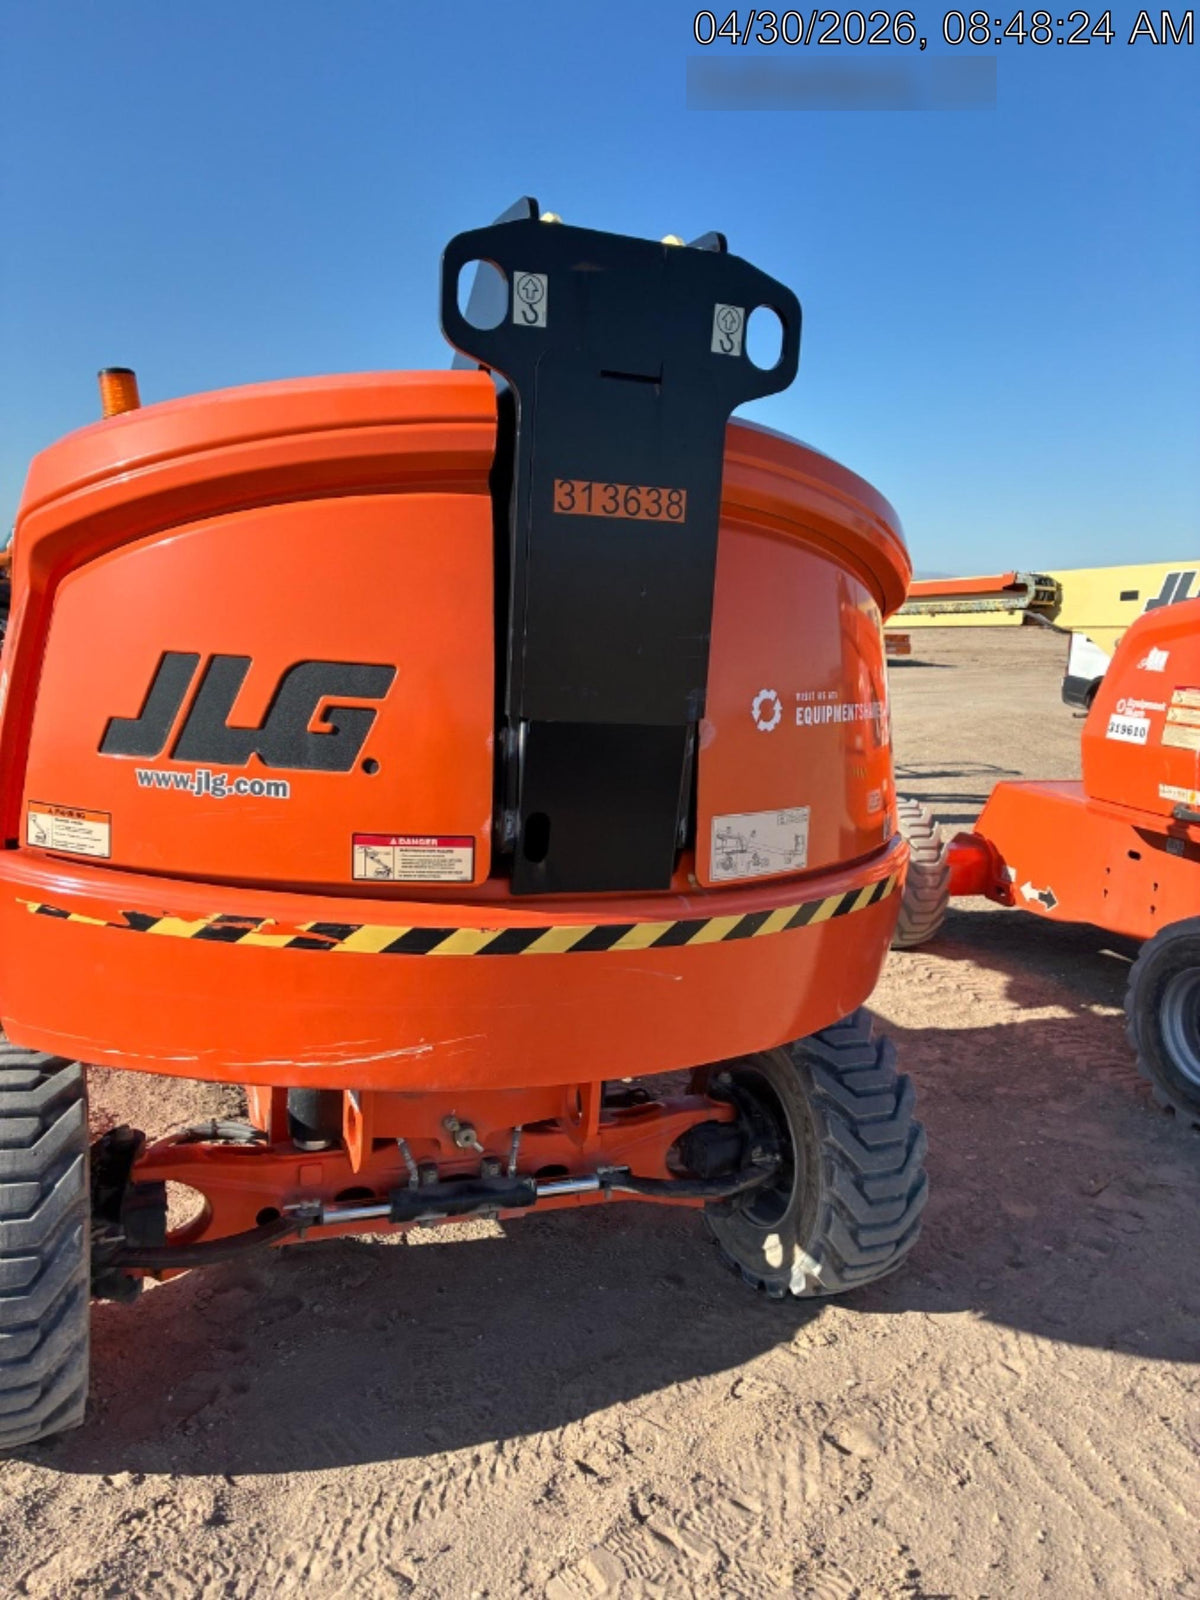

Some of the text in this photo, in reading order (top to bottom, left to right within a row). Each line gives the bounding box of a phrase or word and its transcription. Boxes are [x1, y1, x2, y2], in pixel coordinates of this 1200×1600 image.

[558, 481, 683, 519] 313638
[1144, 572, 1200, 612] JL
[97, 650, 399, 774] JLG
[1109, 721, 1146, 738] 319610
[136, 769, 290, 797] www.jlg.com
[398, 838, 438, 846] DANGER
